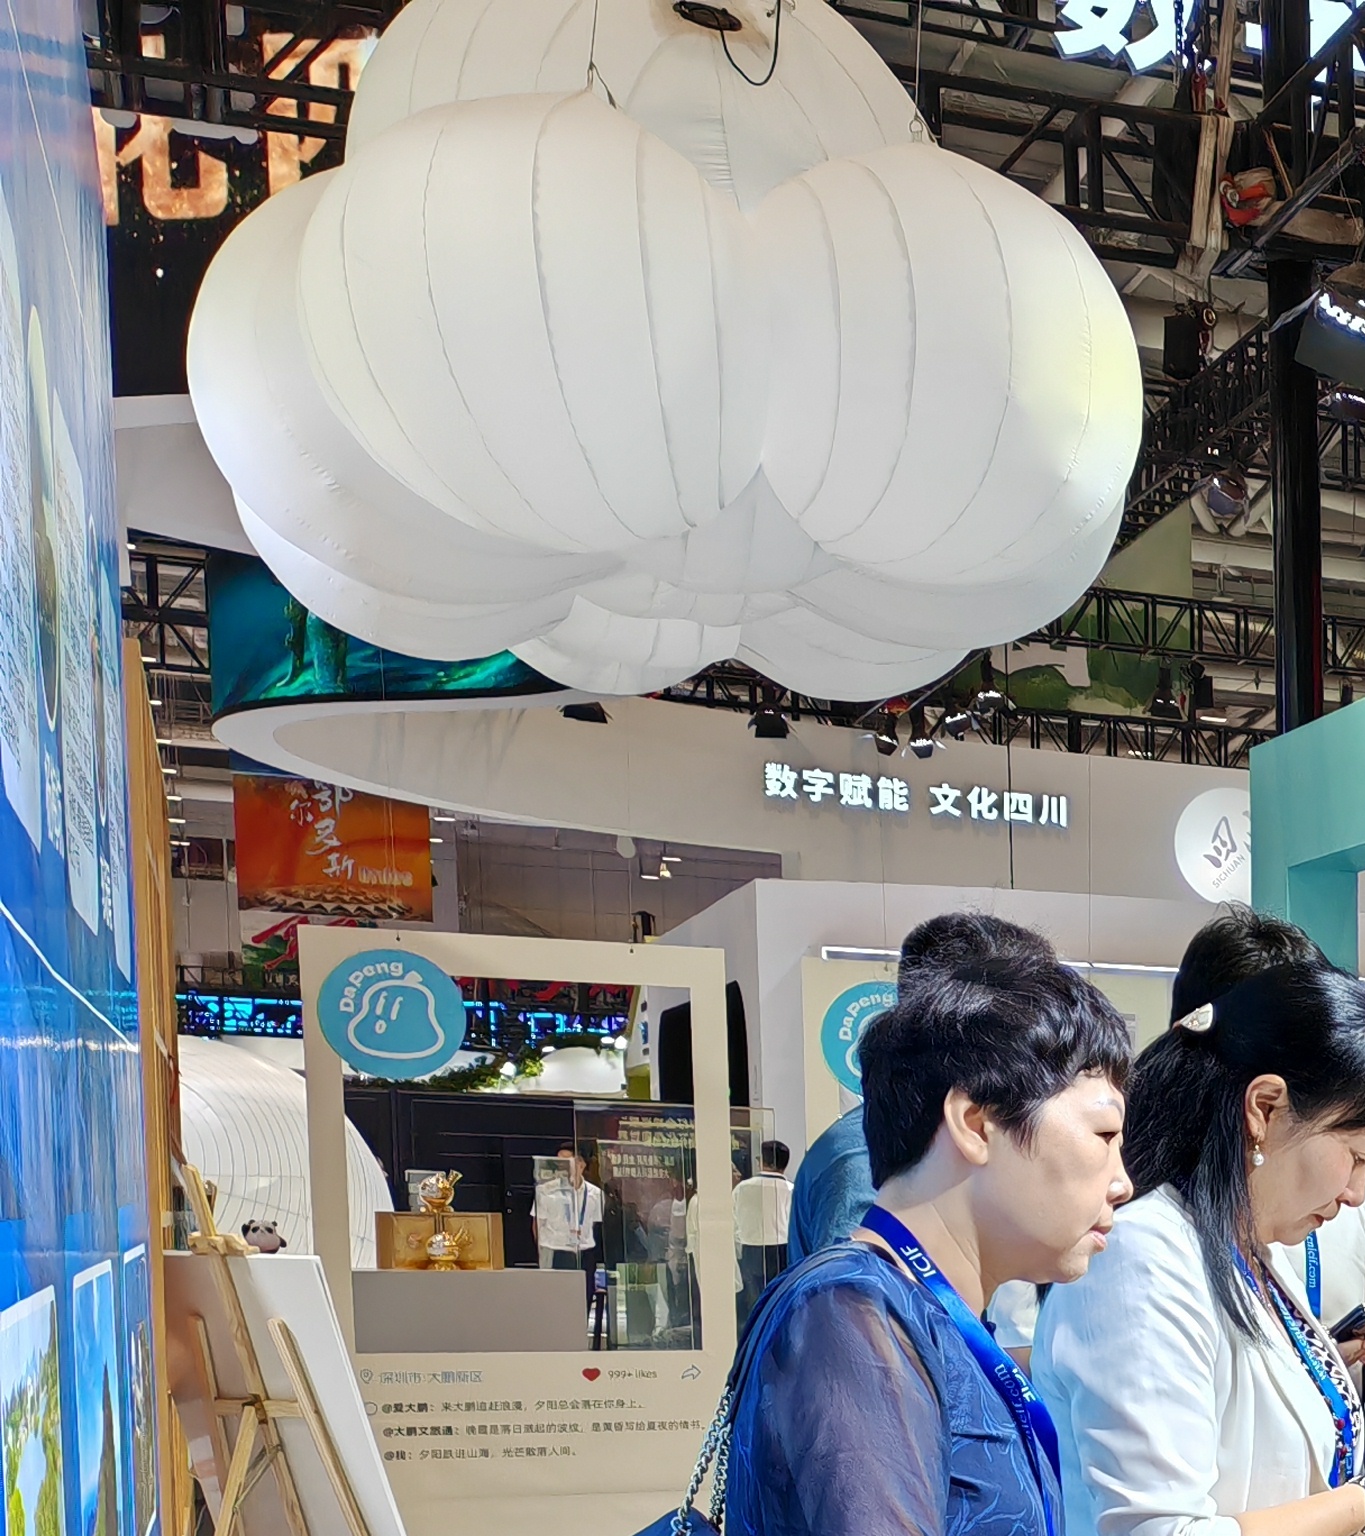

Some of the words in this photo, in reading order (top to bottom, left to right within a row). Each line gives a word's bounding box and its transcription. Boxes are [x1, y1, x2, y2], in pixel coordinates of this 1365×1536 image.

[763, 763, 910, 812] 数字赋能
[929, 782, 1069, 829] 文化四川
[340, 962, 403, 1013] DaPeng
[839, 993, 894, 1041] DaPeng
[900, 1245, 936, 1277] ICIF
